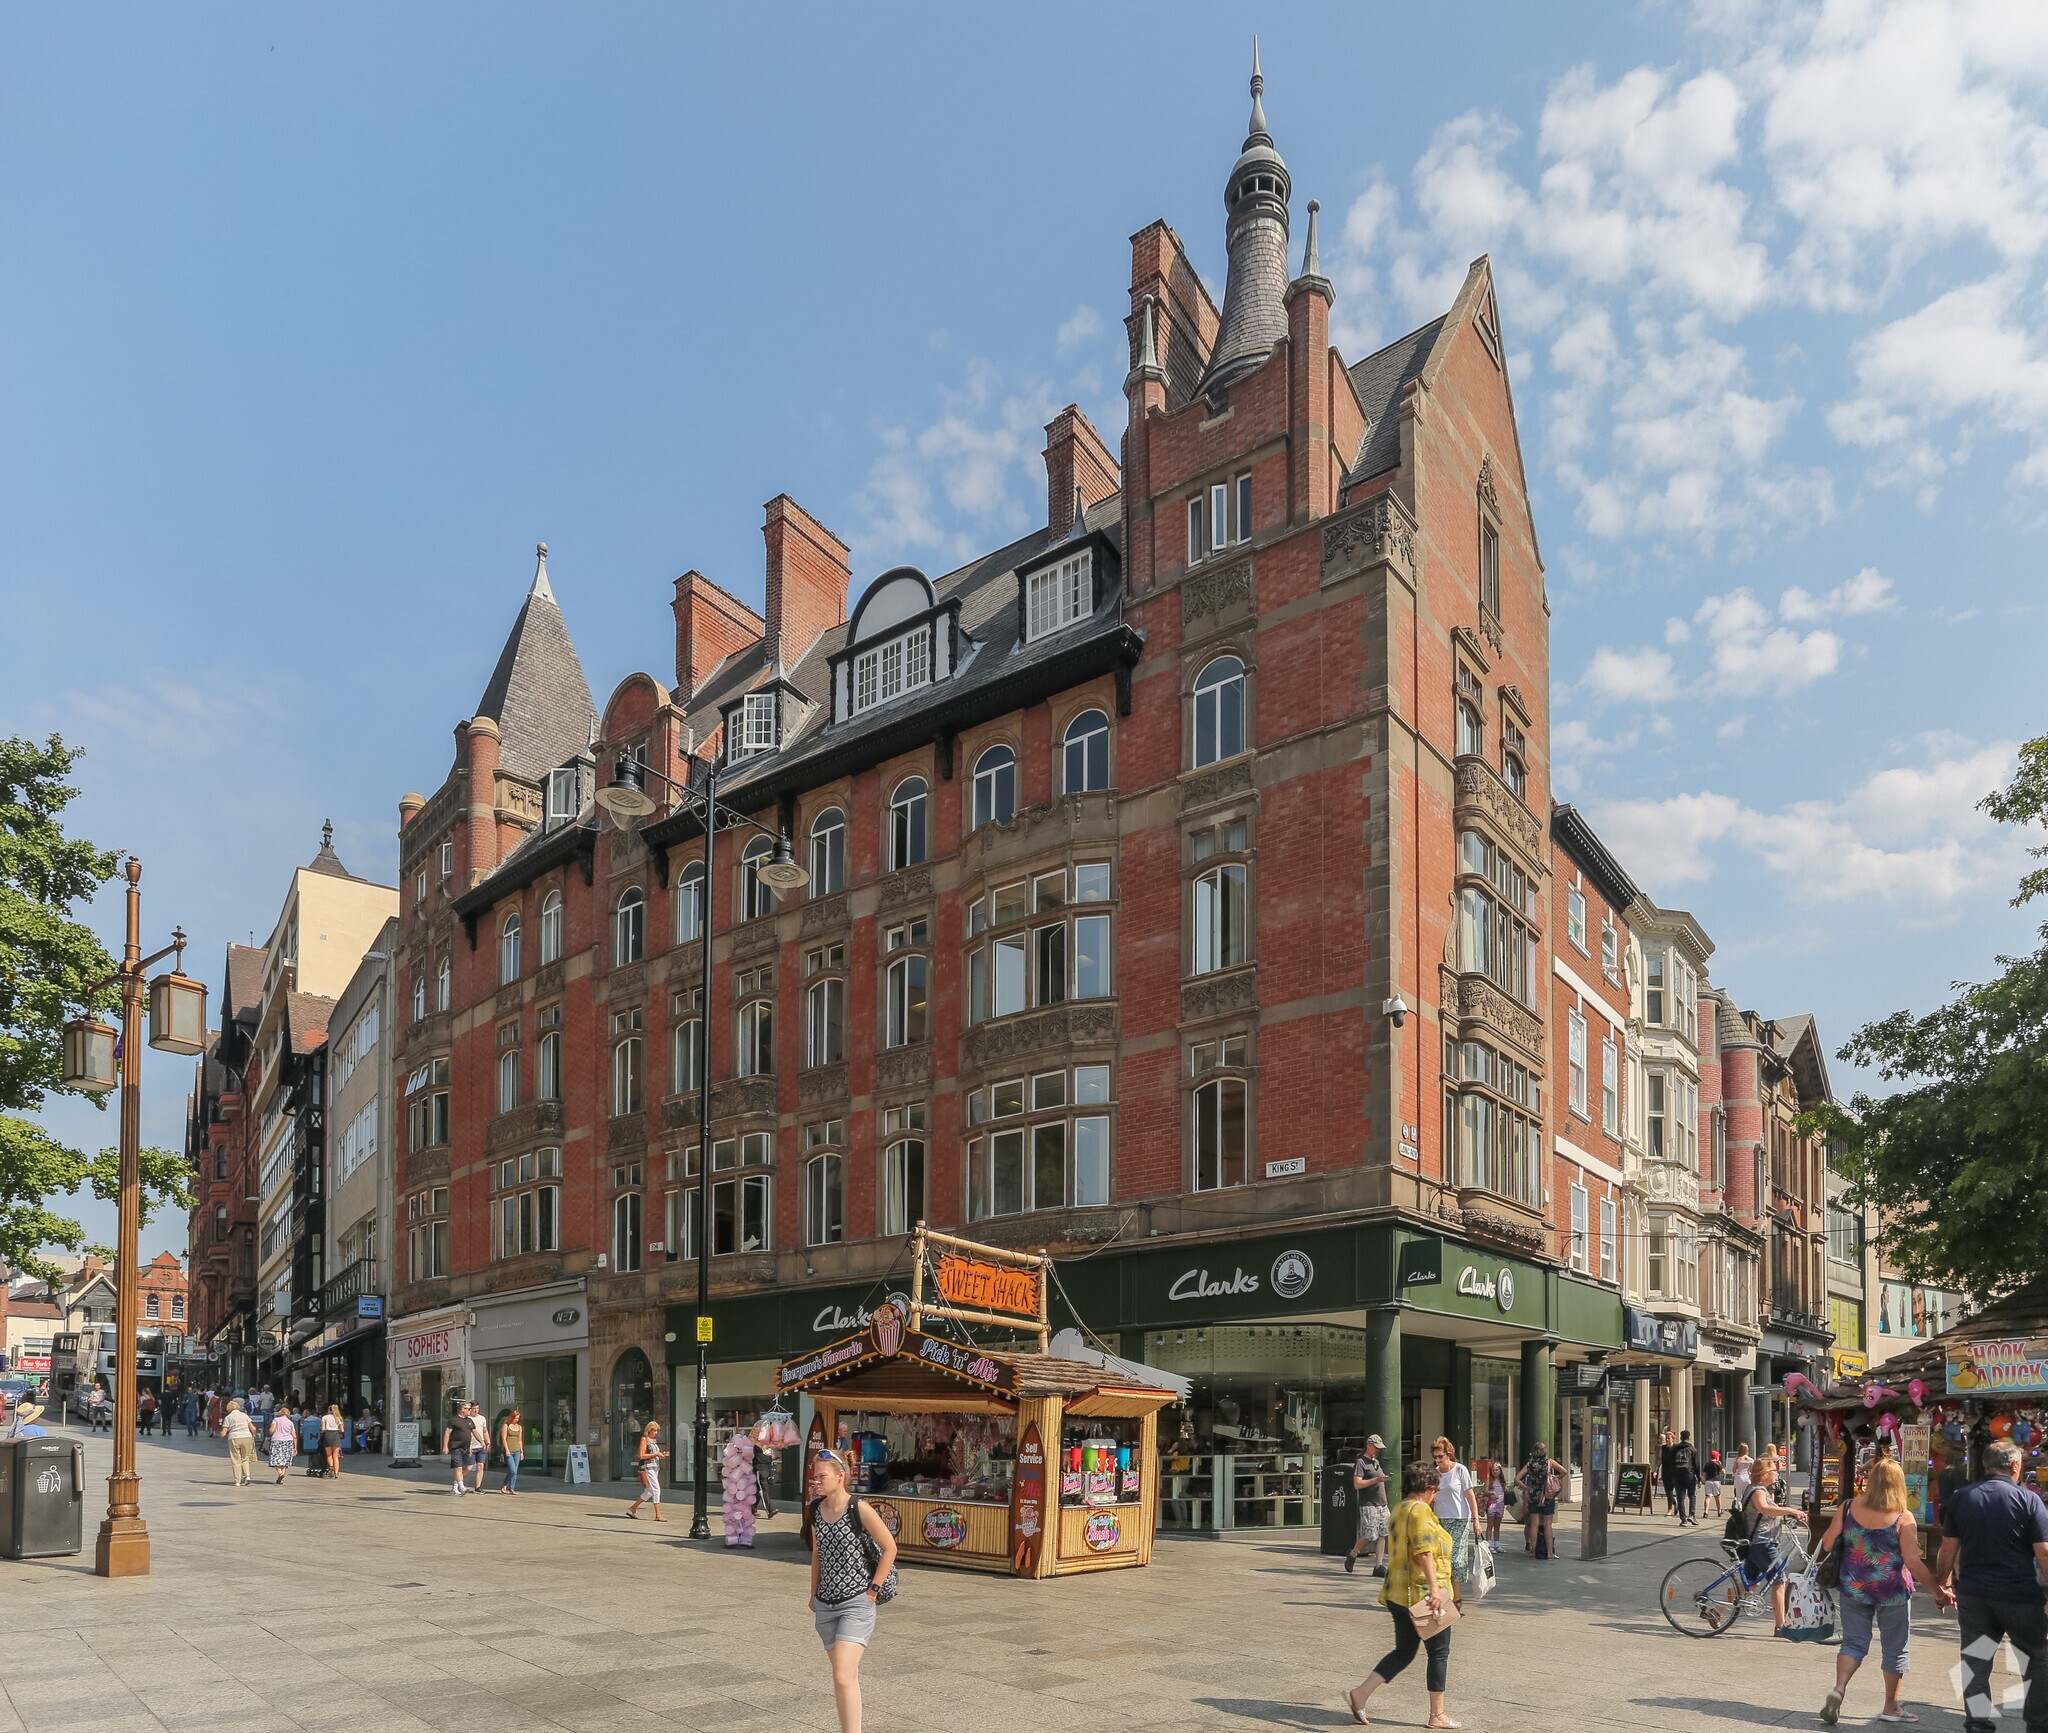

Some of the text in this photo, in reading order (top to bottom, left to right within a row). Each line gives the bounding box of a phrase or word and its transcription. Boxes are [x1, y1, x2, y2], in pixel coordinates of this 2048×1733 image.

[1271, 1162, 1289, 1174] KING
[1168, 1267, 1260, 1301] Clarks
[1407, 1271, 1437, 1282] Clarks
[1459, 1265, 1496, 1299] Clarks
[944, 1268, 1030, 1309] SWEET SHACK
[556, 1310, 575, 1322] NET
[22, 1359, 48, 1368] New York
[144, 1359, 152, 1367] 25
[781, 1341, 863, 1384] Everyone's Favourite
[920, 1338, 949, 1364] Pick
[967, 1357, 999, 1383] Mix
[1976, 1368, 1991, 1391] A
[498, 1385, 515, 1404] TRAM
[812, 1431, 821, 1440] Self
[808, 1440, 825, 1450] Service
[1025, 1443, 1038, 1453] Self
[1019, 1453, 1043, 1464] Service
[1020, 1481, 1042, 1497] Mix
[925, 1523, 953, 1538] Slush
[1087, 1526, 1110, 1541] Slush
